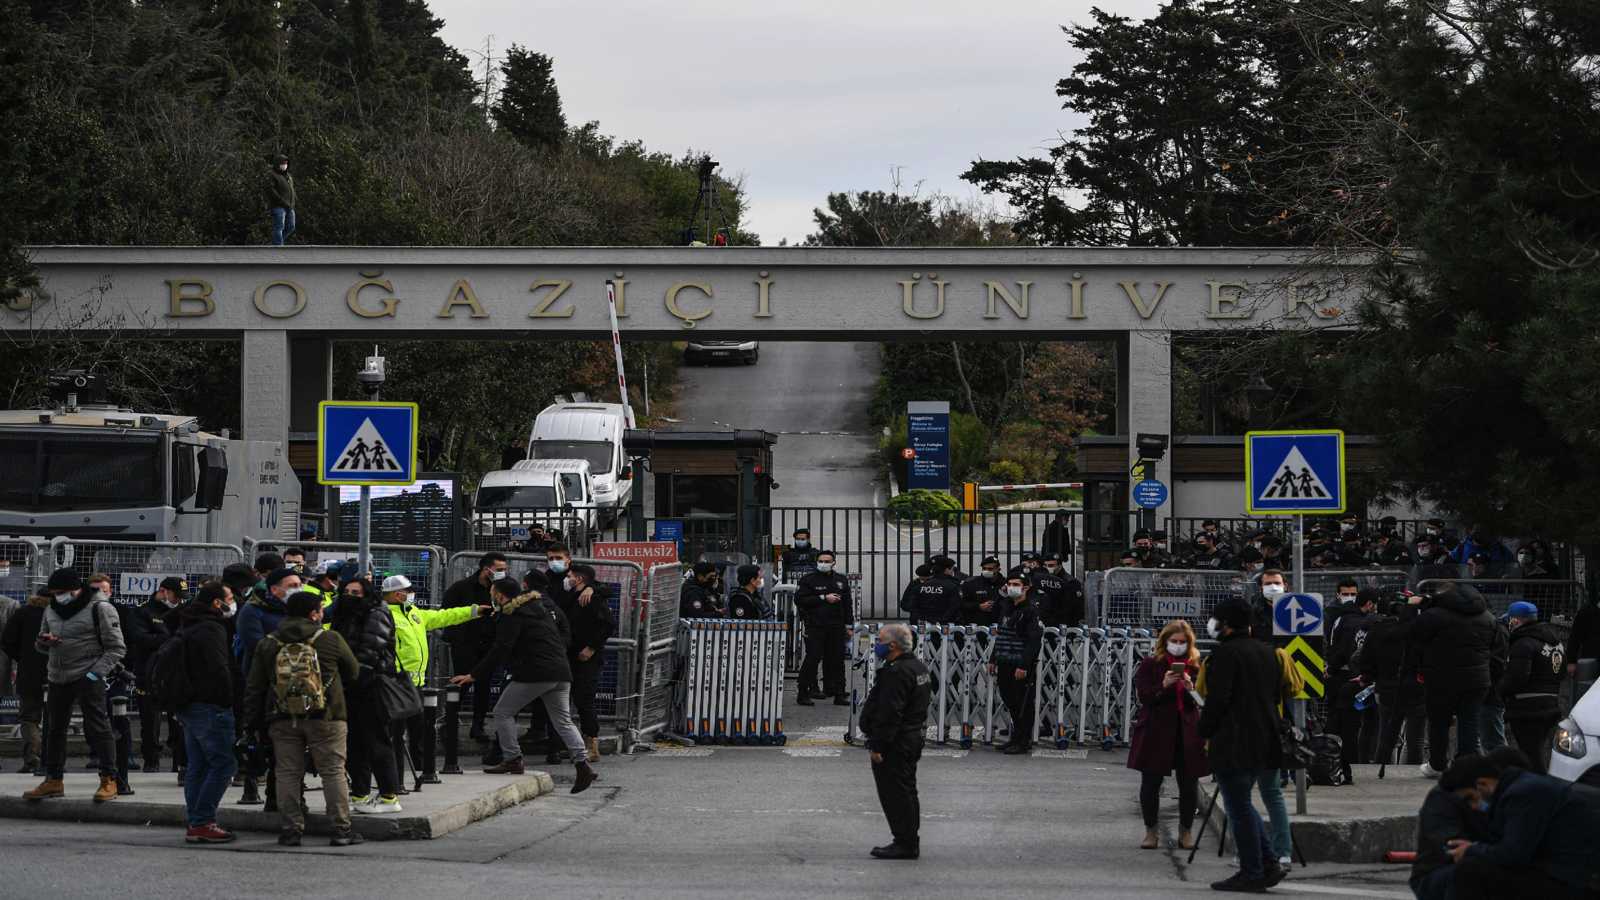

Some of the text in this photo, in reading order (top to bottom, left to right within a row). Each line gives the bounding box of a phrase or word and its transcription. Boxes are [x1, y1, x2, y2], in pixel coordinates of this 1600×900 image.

[165, 271, 1341, 329] BOĞAZİÇİ ÜNİVER
[259, 496, 278, 529] T70
[599, 544, 674, 557] AMBLEMSİZ
[128, 576, 160, 592] POL
